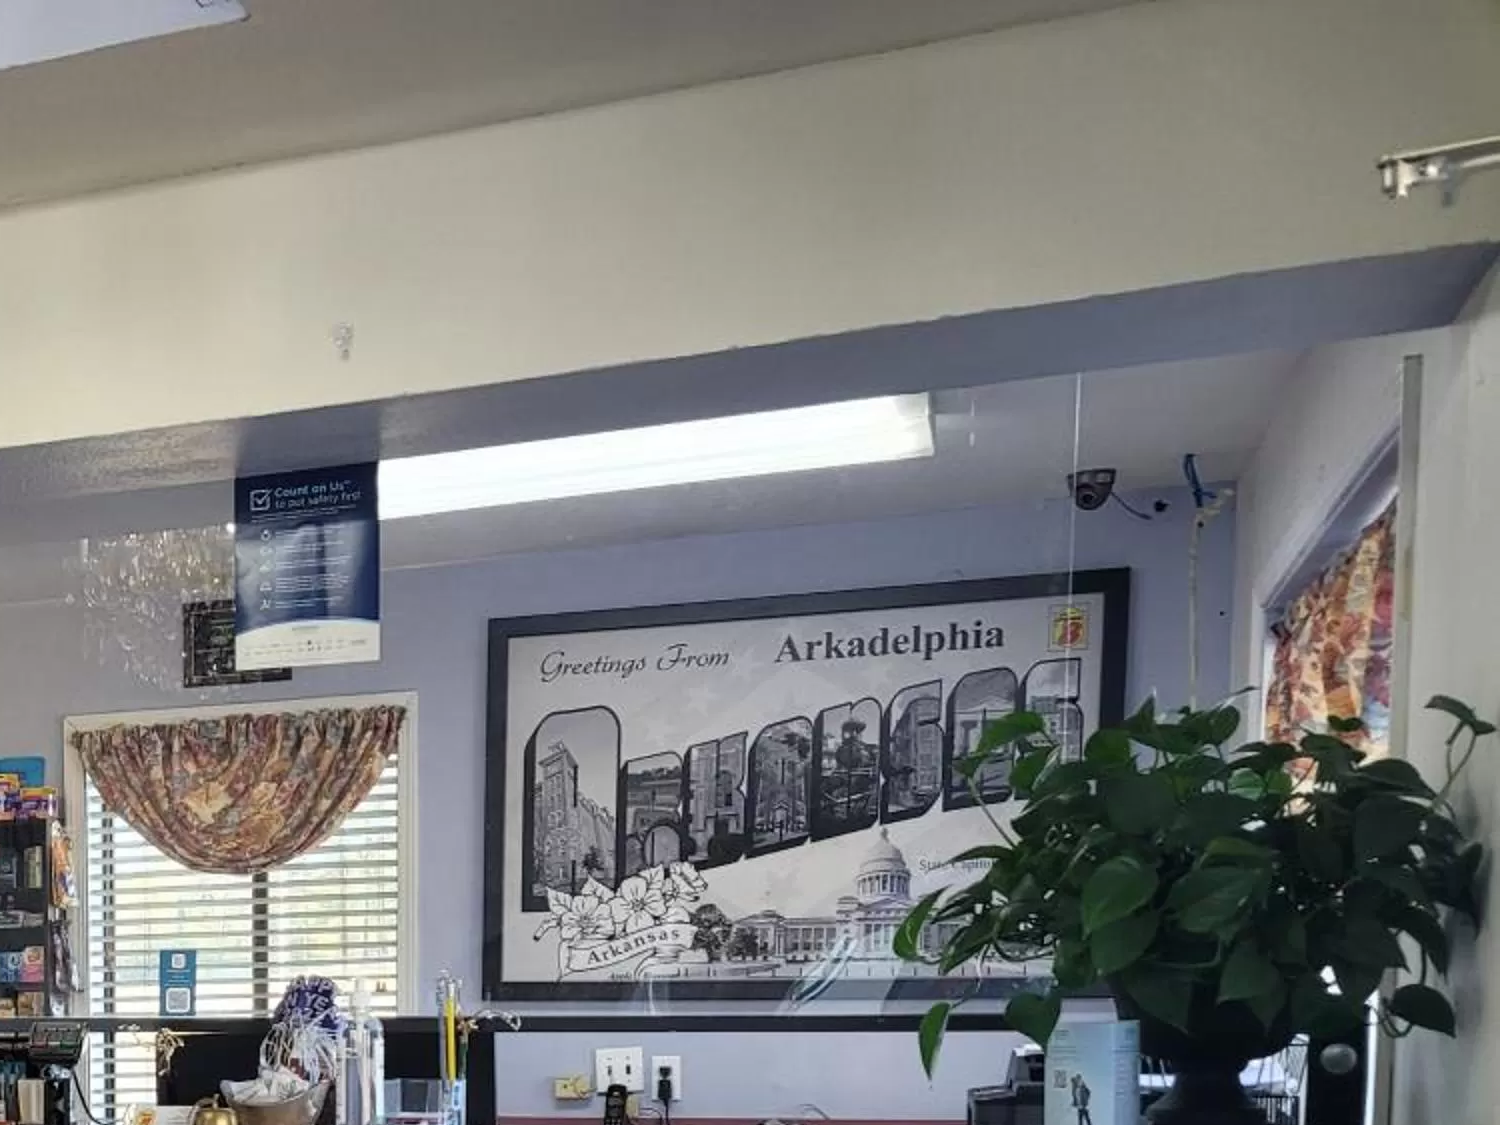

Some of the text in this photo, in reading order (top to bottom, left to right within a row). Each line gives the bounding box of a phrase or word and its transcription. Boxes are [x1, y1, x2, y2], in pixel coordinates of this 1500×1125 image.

[274, 486, 309, 498] Count
[311, 484, 327, 494] on
[275, 499, 286, 509] to
[287, 498, 305, 508] put
[308, 494, 339, 506] safety
[773, 619, 1006, 666] Arkadelphia
[540, 643, 731, 683] Greetings From
[587, 928, 681, 965] Arkansas
